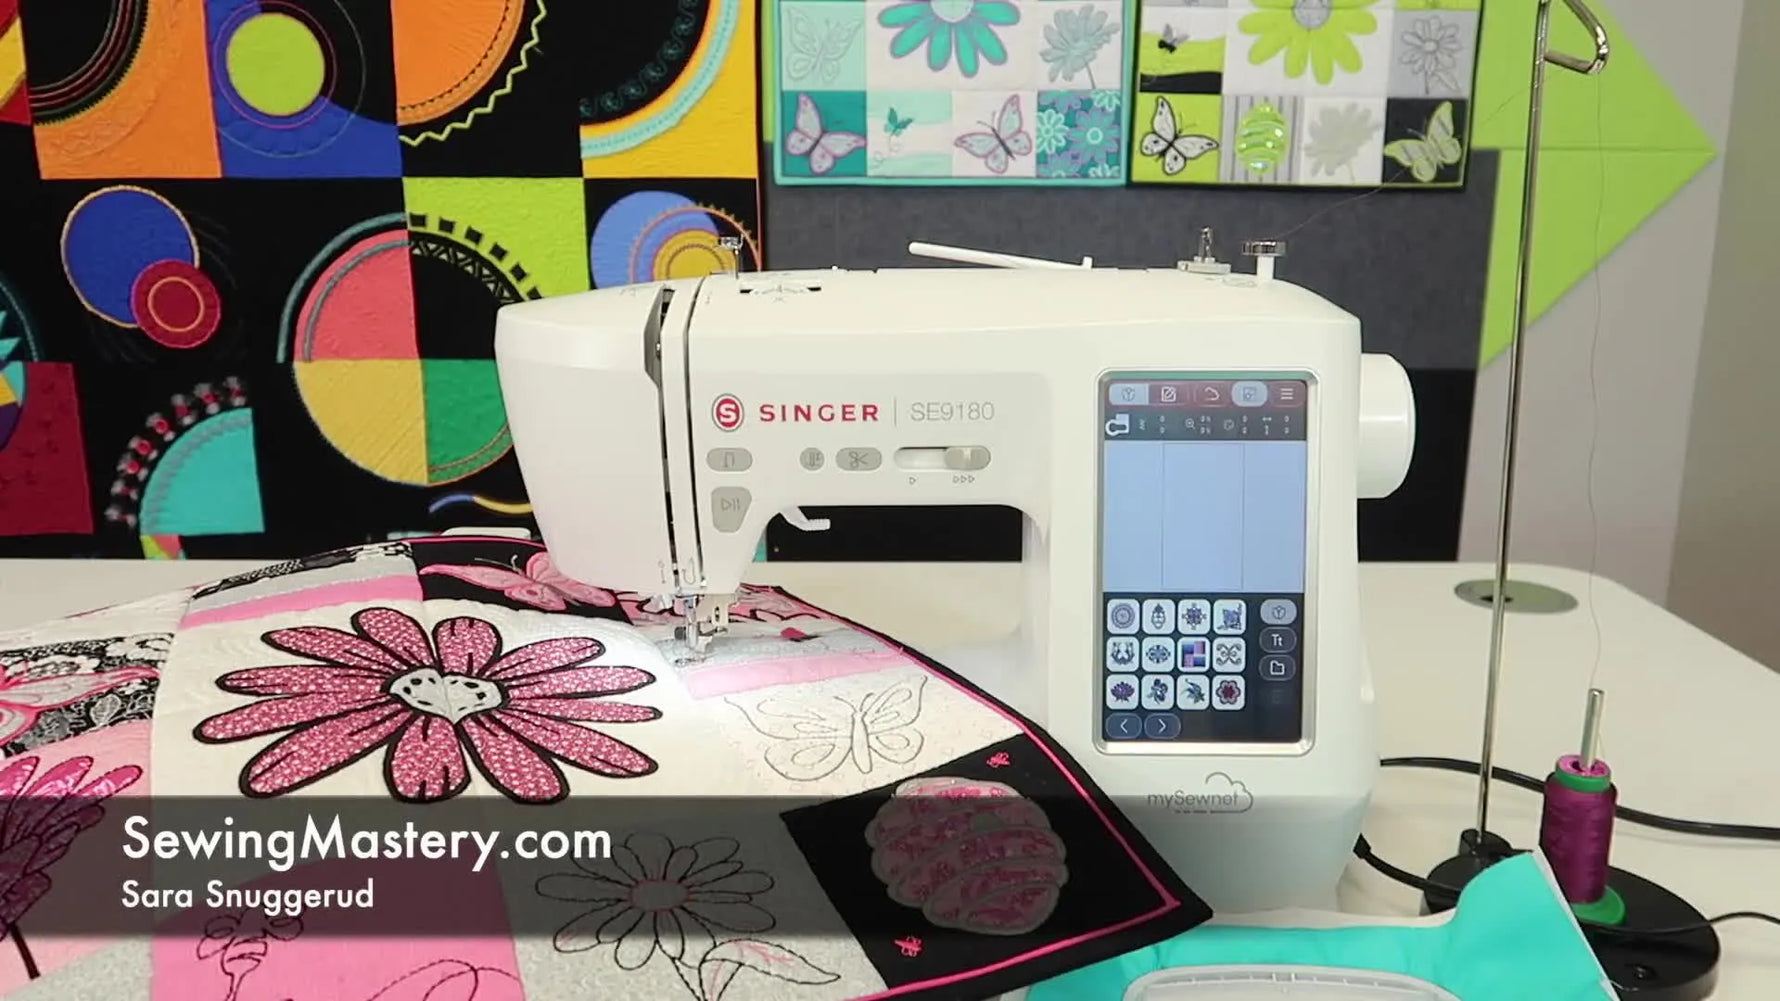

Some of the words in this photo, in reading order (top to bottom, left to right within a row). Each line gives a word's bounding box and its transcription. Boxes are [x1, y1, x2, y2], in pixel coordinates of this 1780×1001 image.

[759, 403, 880, 423] SINGER
[910, 401, 995, 422] SE9180
[1147, 789, 1239, 809] mySewnet
